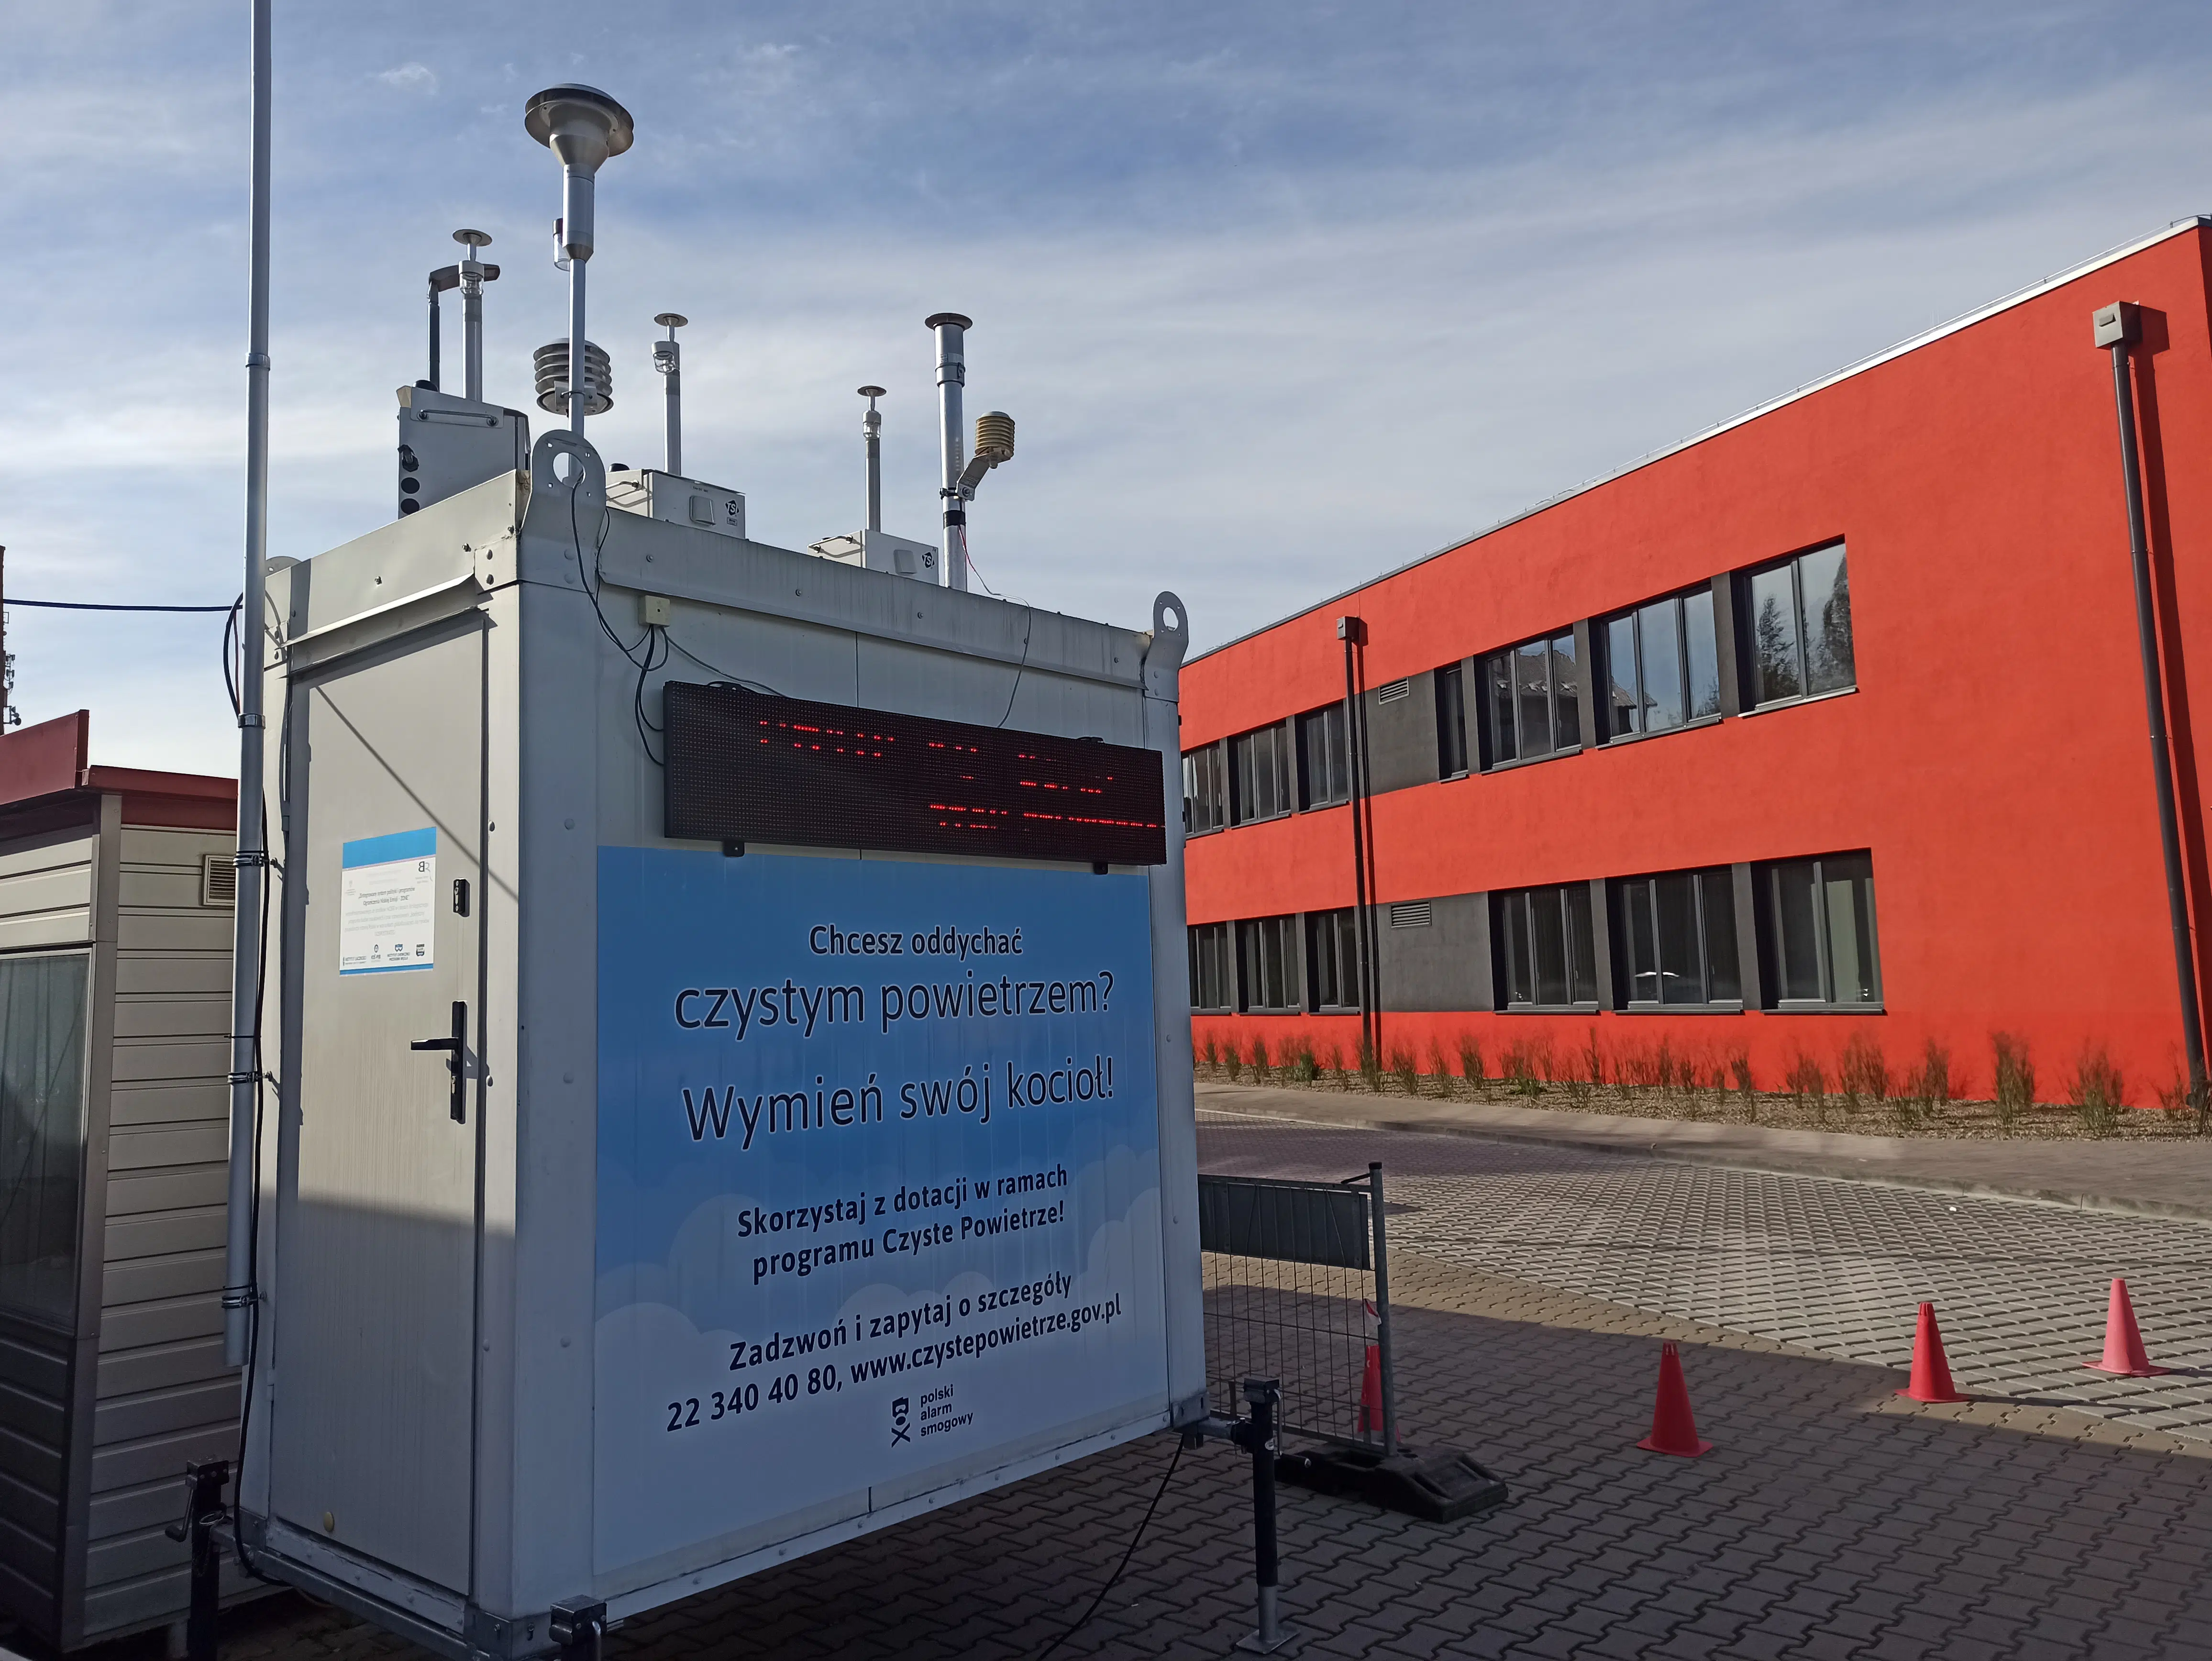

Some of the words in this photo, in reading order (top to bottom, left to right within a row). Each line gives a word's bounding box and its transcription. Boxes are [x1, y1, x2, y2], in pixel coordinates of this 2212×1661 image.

[726, 501, 739, 515] TSI
[922, 553, 934, 567] TSI
[809, 924, 903, 954] Chcesz
[911, 926, 1022, 961] oddychać
[675, 979, 864, 1041] czystym
[881, 970, 1114, 1033] powietrzem?
[683, 1073, 882, 1151] Wymień
[900, 1063, 990, 1124] swój
[1007, 1055, 1113, 1107] kocioł!
[737, 1192, 865, 1238] Skorzystaj
[874, 1196, 886, 1216] z
[893, 1177, 967, 1213] dotacji
[974, 1180, 991, 1199] w
[997, 1163, 1067, 1196] ramach
[753, 1238, 874, 1286] programu
[882, 1223, 953, 1256] Czyste
[960, 1200, 1065, 1240] Powietrze!
[729, 1318, 847, 1371] Zadzwoń
[855, 1314, 862, 1341] i
[869, 1295, 952, 1339] zapytaj
[958, 1297, 971, 1317] o
[977, 1270, 1072, 1312] szczegóły
[667, 1398, 700, 1432] 22
[710, 1383, 759, 1420] 340
[767, 1373, 799, 1404] 40
[807, 1364, 843, 1395] 80,
[850, 1292, 1122, 1384] www.czystepowietrze.gov.pl
[920, 1384, 954, 1406] polski
[920, 1402, 953, 1421] alarm
[920, 1410, 974, 1437] smogowy
